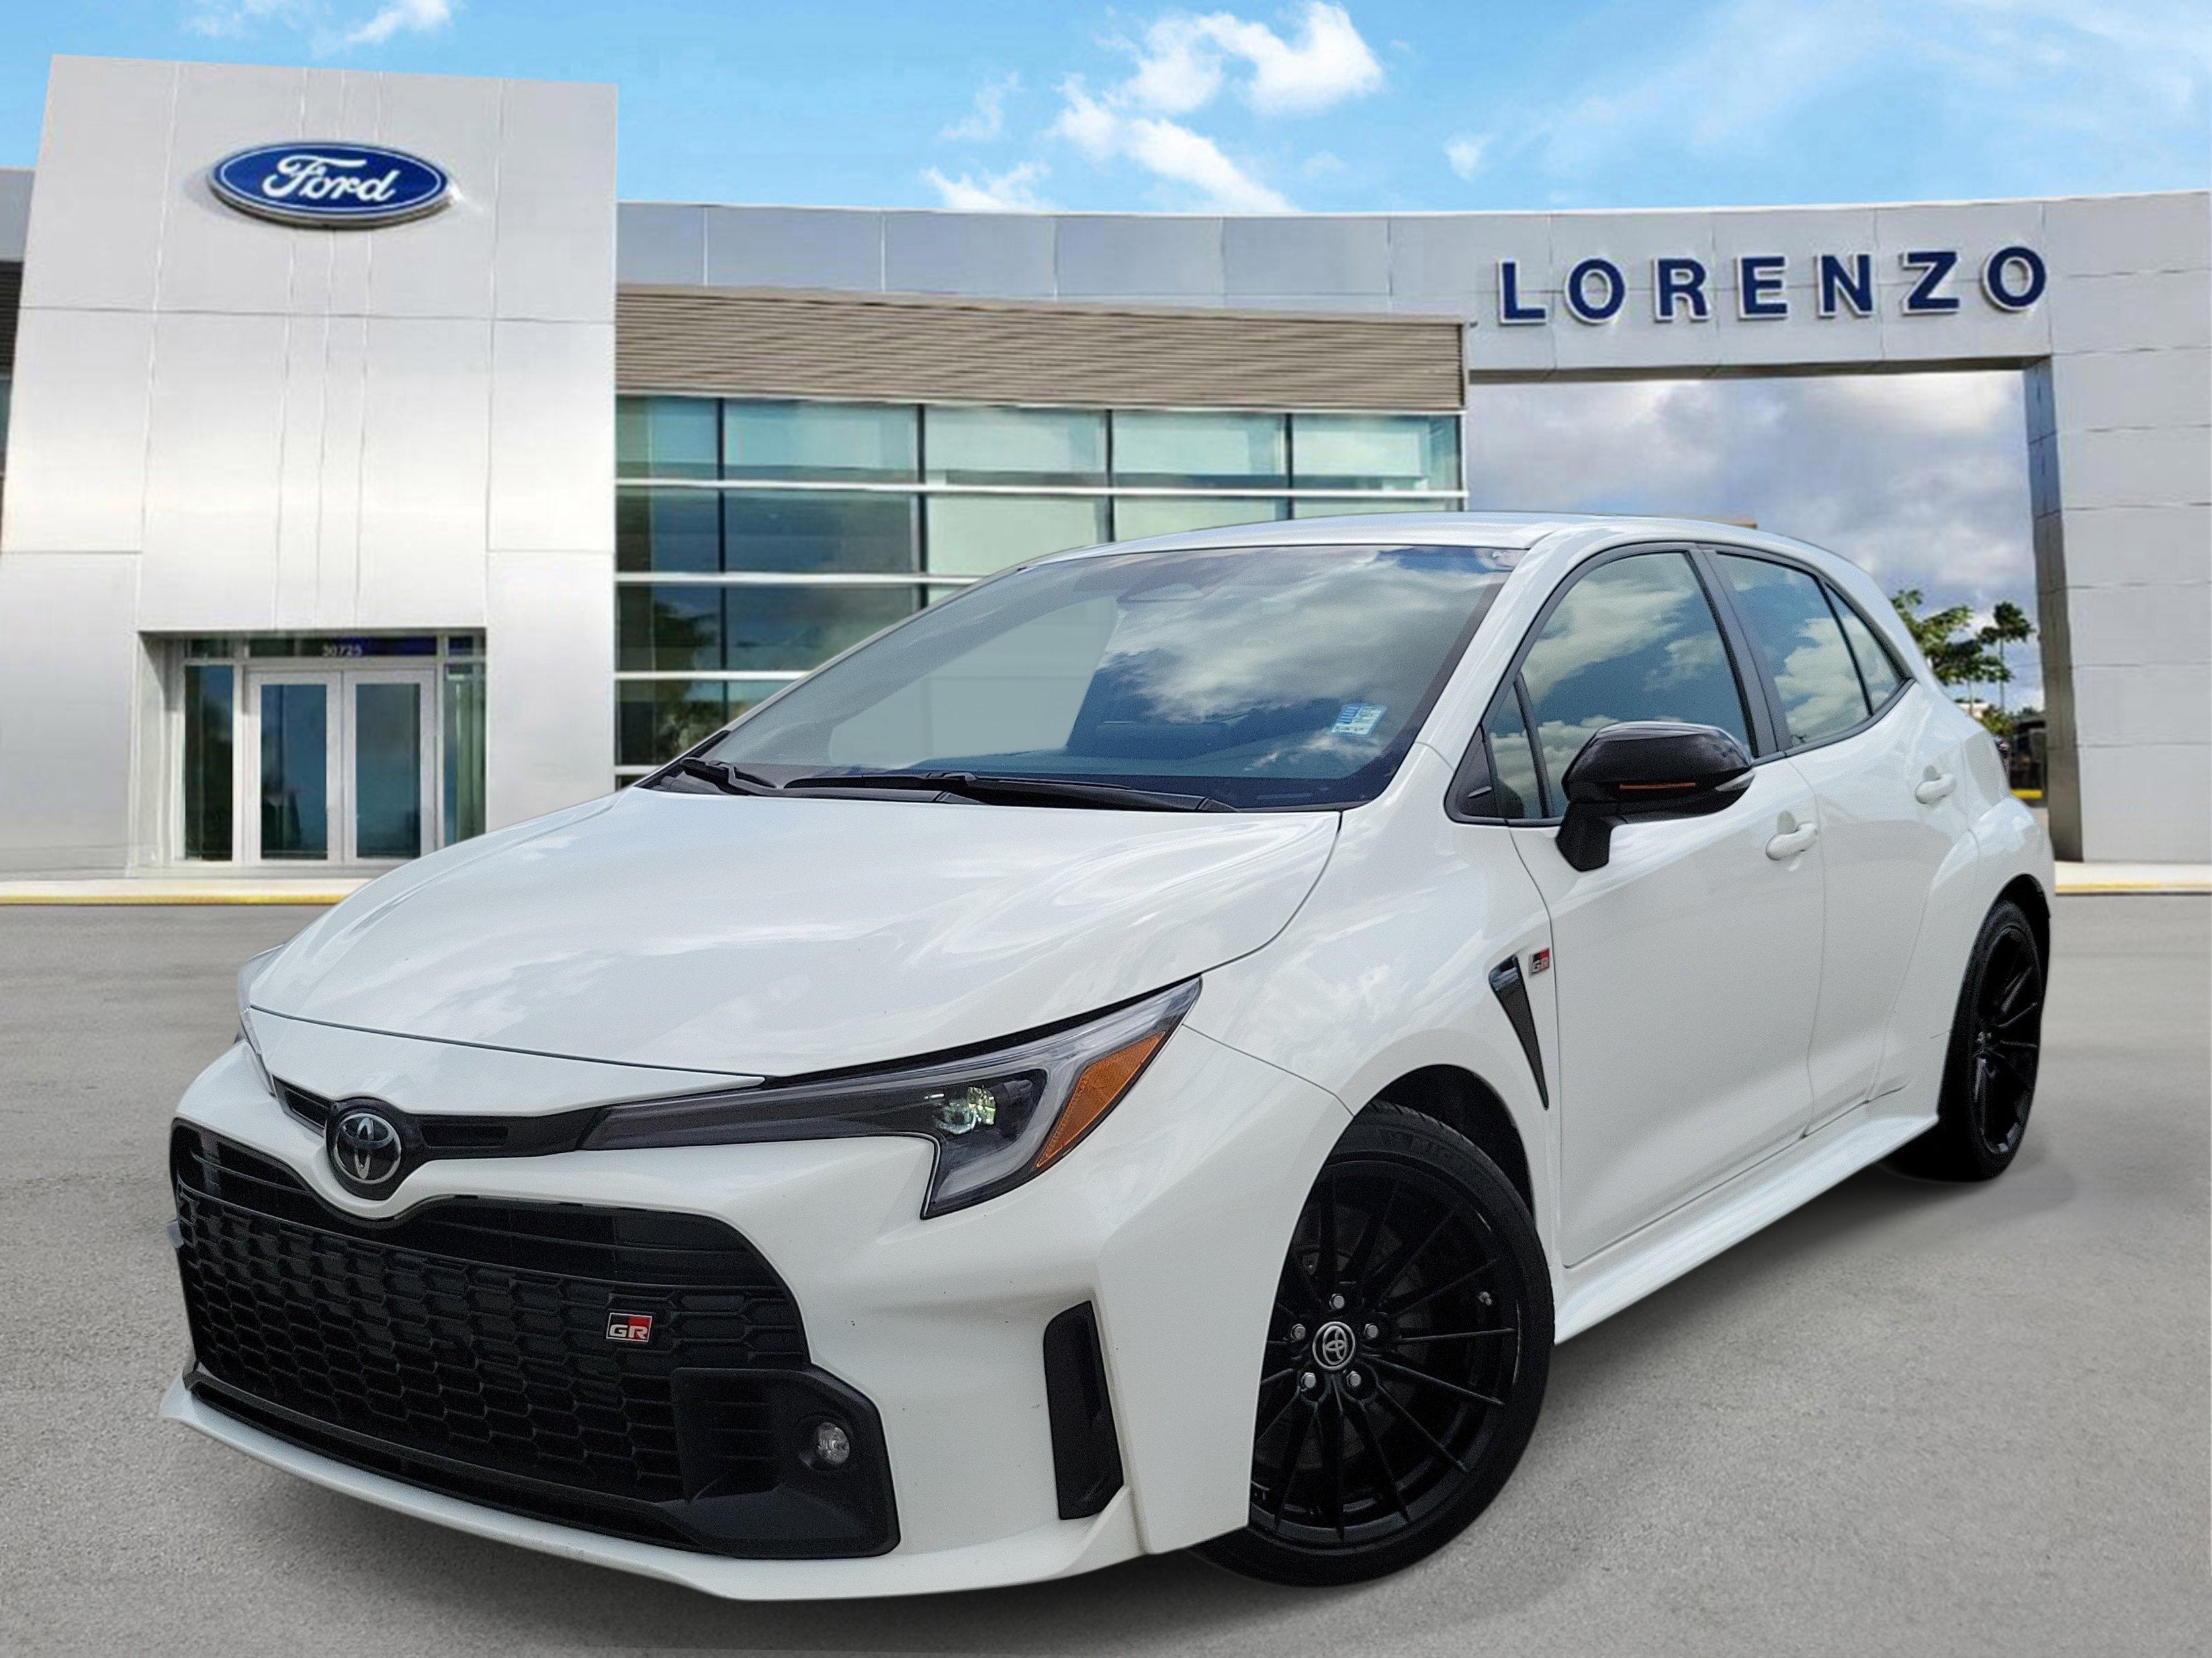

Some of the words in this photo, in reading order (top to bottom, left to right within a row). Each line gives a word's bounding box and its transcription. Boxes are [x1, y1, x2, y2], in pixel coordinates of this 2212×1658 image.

[263, 154, 400, 201] Ford
[1497, 246, 2047, 324] LORENZO
[610, 1324, 648, 1339] GR
